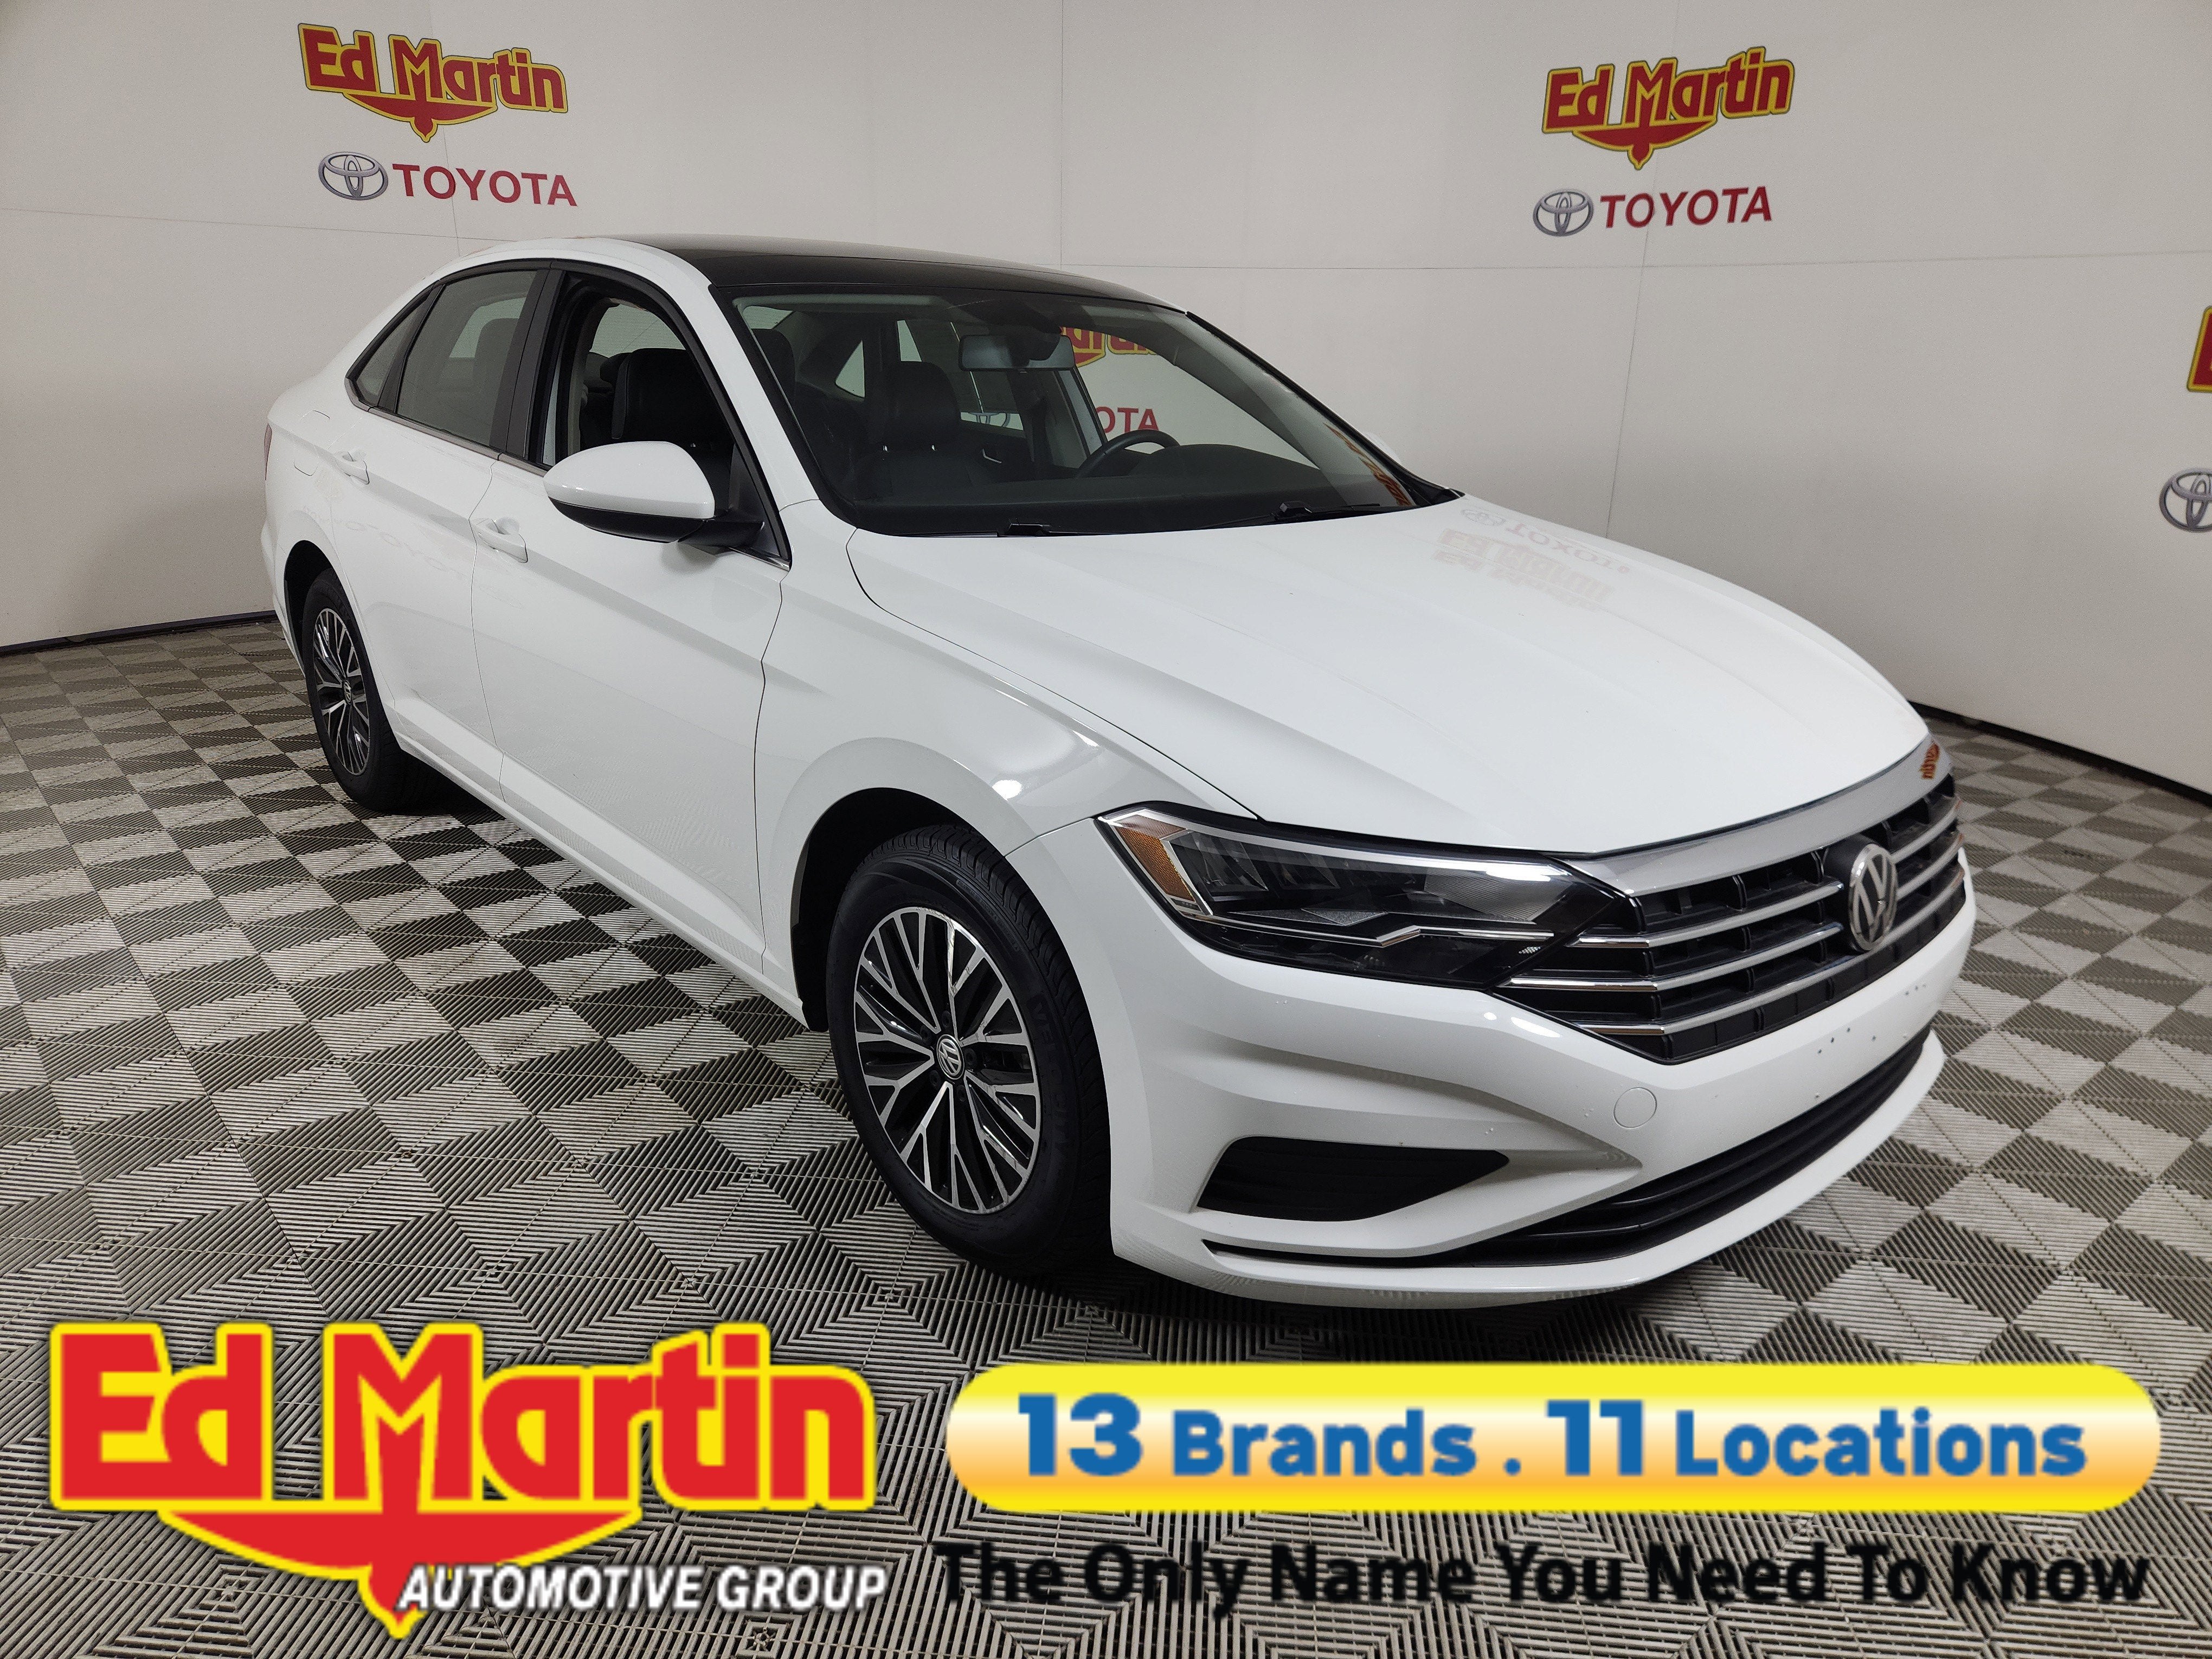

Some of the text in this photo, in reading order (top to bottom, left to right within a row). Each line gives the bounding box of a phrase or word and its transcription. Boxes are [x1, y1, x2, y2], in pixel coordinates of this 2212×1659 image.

[301, 26, 565, 111] Ed Martin
[1545, 49, 1792, 130] Ed Martin
[392, 163, 578, 207] TOYOTA
[1599, 186, 1773, 229] TOYOTA
